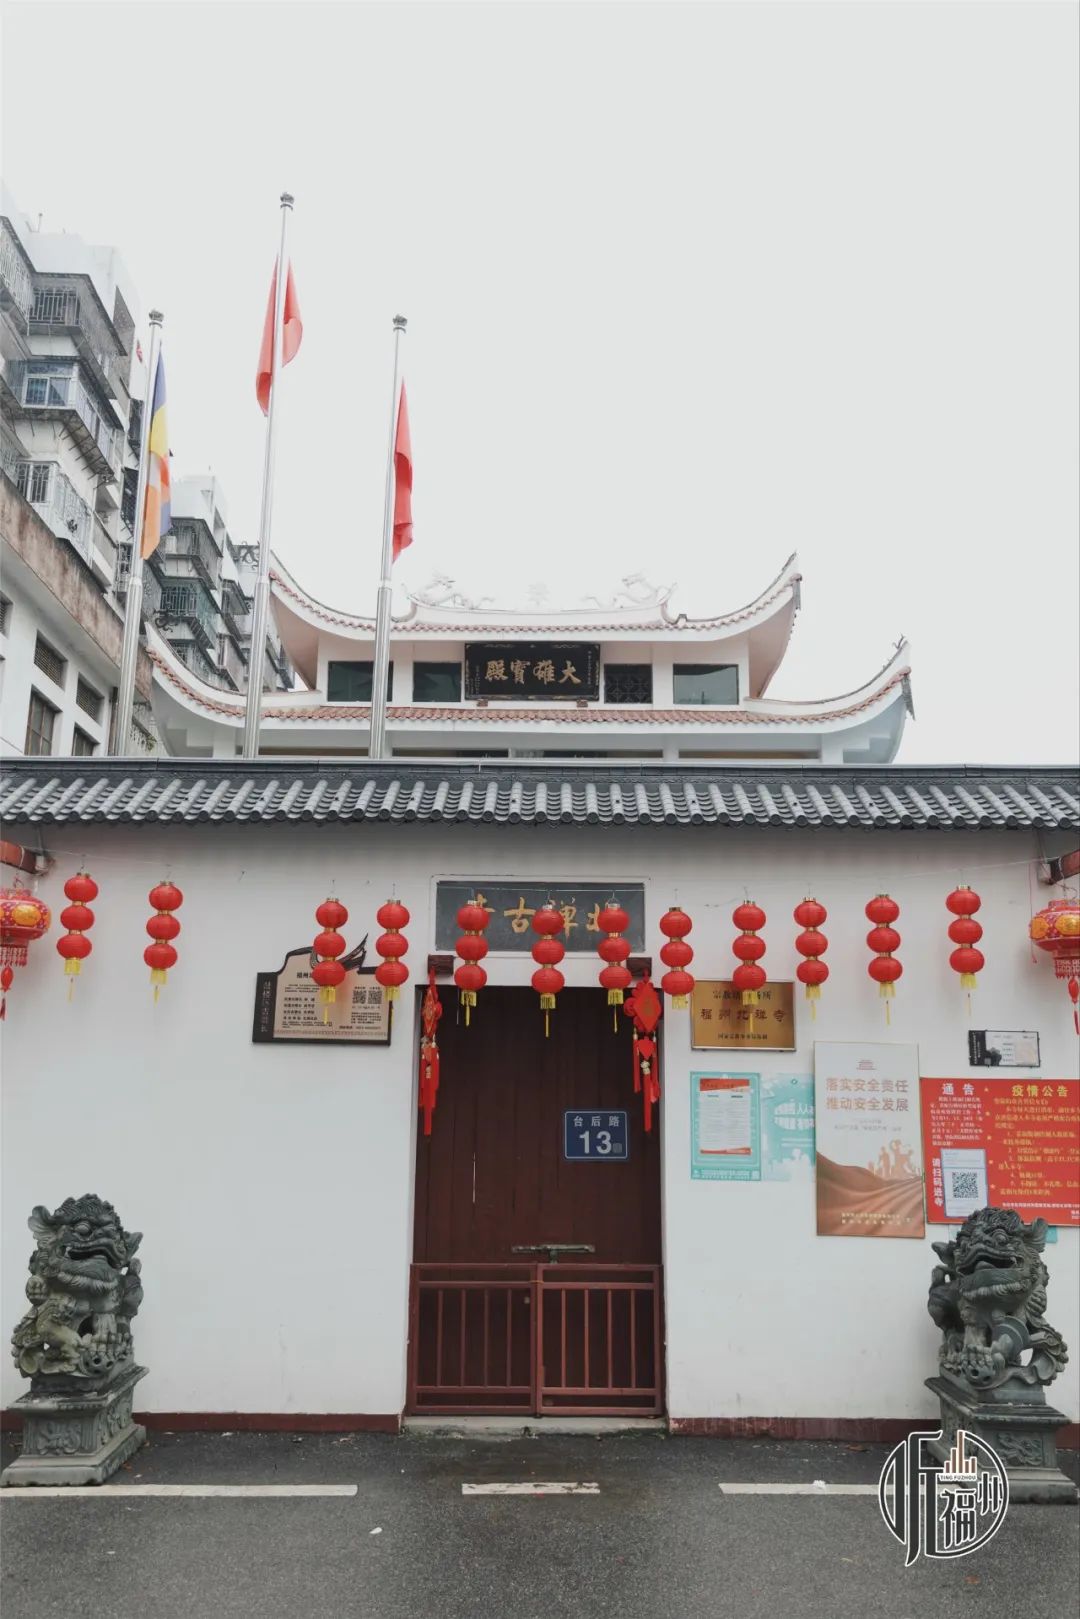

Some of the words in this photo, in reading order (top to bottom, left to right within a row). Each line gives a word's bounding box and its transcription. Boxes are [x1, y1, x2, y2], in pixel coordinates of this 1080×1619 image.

[826, 1078, 909, 1093] 落实安全责任
[1012, 1085, 1069, 1097] 疫情公告
[826, 1097, 909, 1112] 推动安全发展
[573, 1115, 620, 1127] 台后路
[579, 1130, 612, 1154] 13
